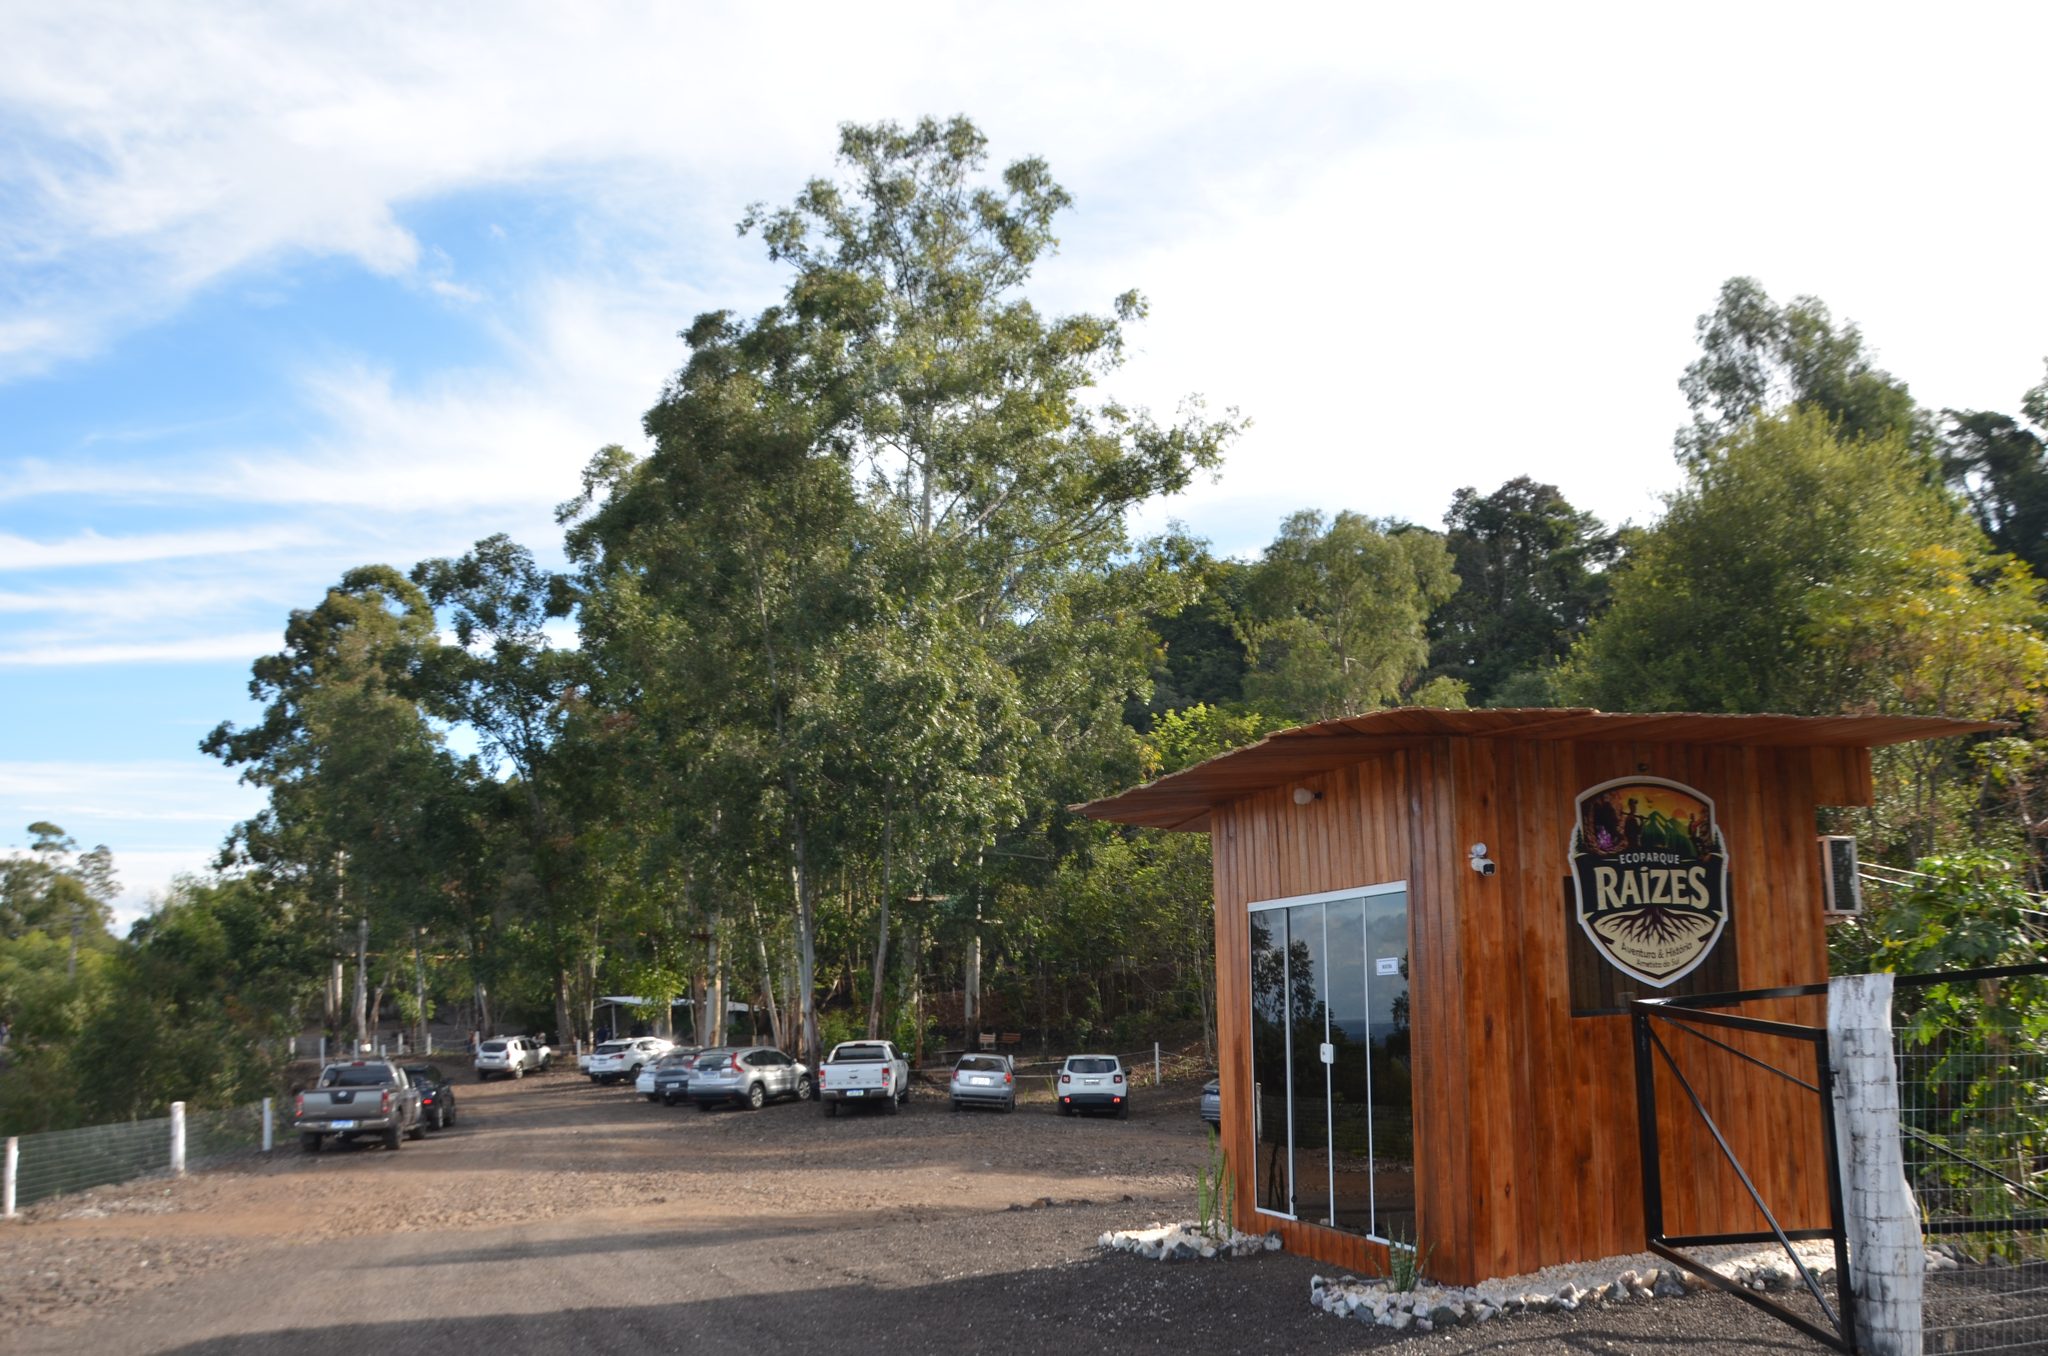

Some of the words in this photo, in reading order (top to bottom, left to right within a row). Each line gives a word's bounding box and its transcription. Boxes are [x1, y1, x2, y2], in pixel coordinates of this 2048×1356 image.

[1619, 852, 1680, 865] ECOPARQUE
[1621, 942, 1656, 958] Aventura
[1658, 949, 1664, 958] &
